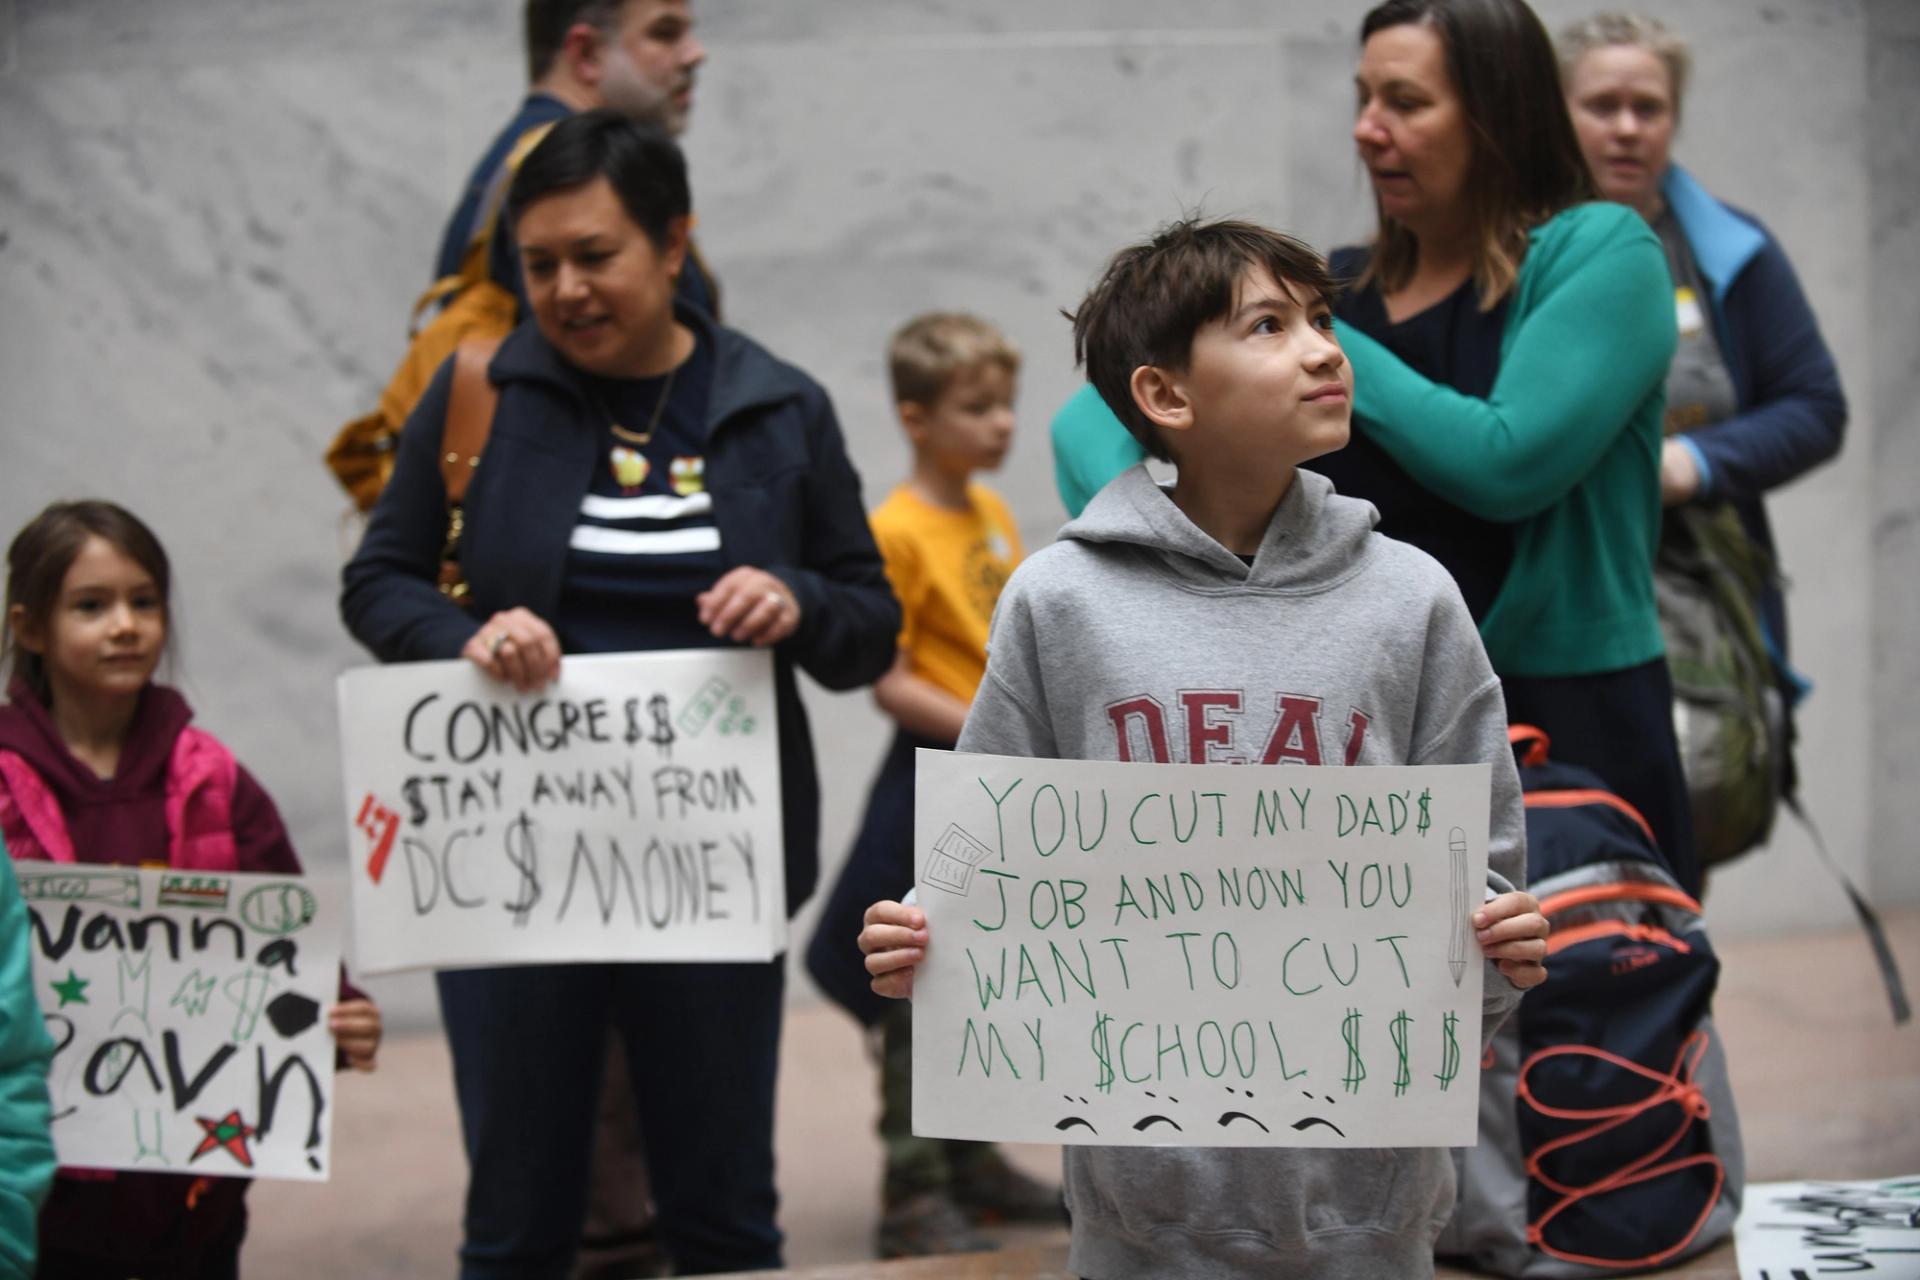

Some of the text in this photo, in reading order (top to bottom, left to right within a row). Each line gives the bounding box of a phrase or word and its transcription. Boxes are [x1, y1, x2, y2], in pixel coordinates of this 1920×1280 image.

[403, 761, 756, 827] $TAY AWAY FROM
[979, 777, 1433, 862] YOU CUT MY DAD'$
[557, 829, 760, 931] MONEY
[972, 860, 1411, 932] JOB AND NOW YOU
[966, 932, 1410, 1011] WANT TO CUT
[957, 1017, 1045, 1082] MY
[1092, 1010, 1307, 1094] $CHOOL
